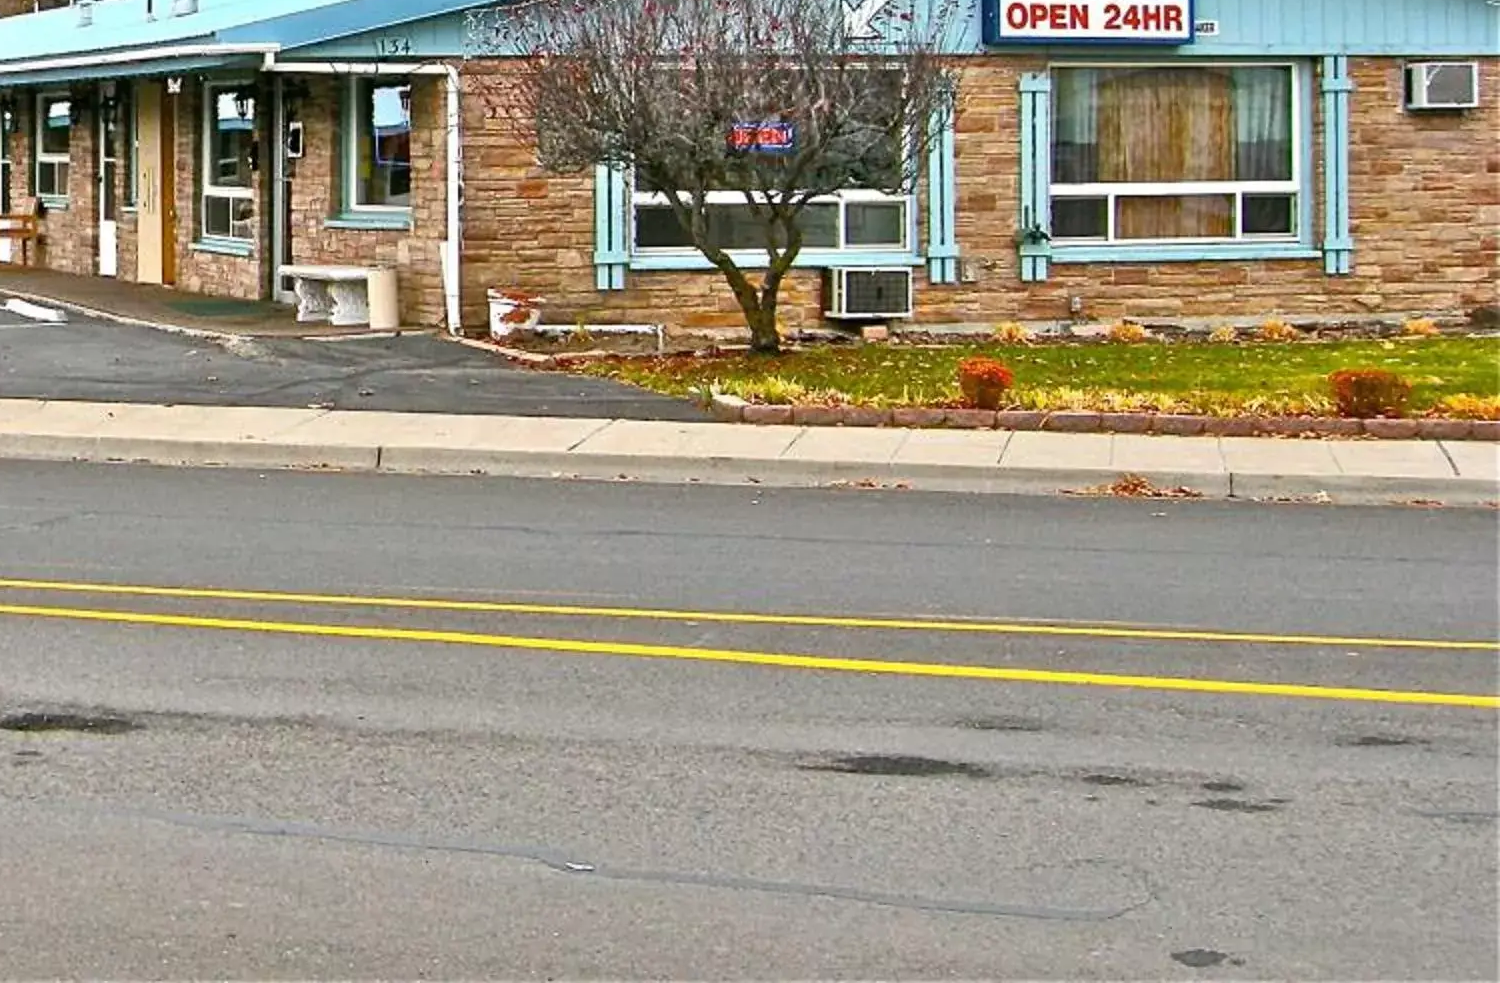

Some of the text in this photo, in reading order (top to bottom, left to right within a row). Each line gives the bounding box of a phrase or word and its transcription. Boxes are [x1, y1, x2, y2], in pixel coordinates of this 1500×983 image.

[1006, 3, 1089, 29] OPEN
[1103, 4, 1183, 31] 24HR
[381, 37, 410, 54] 134
